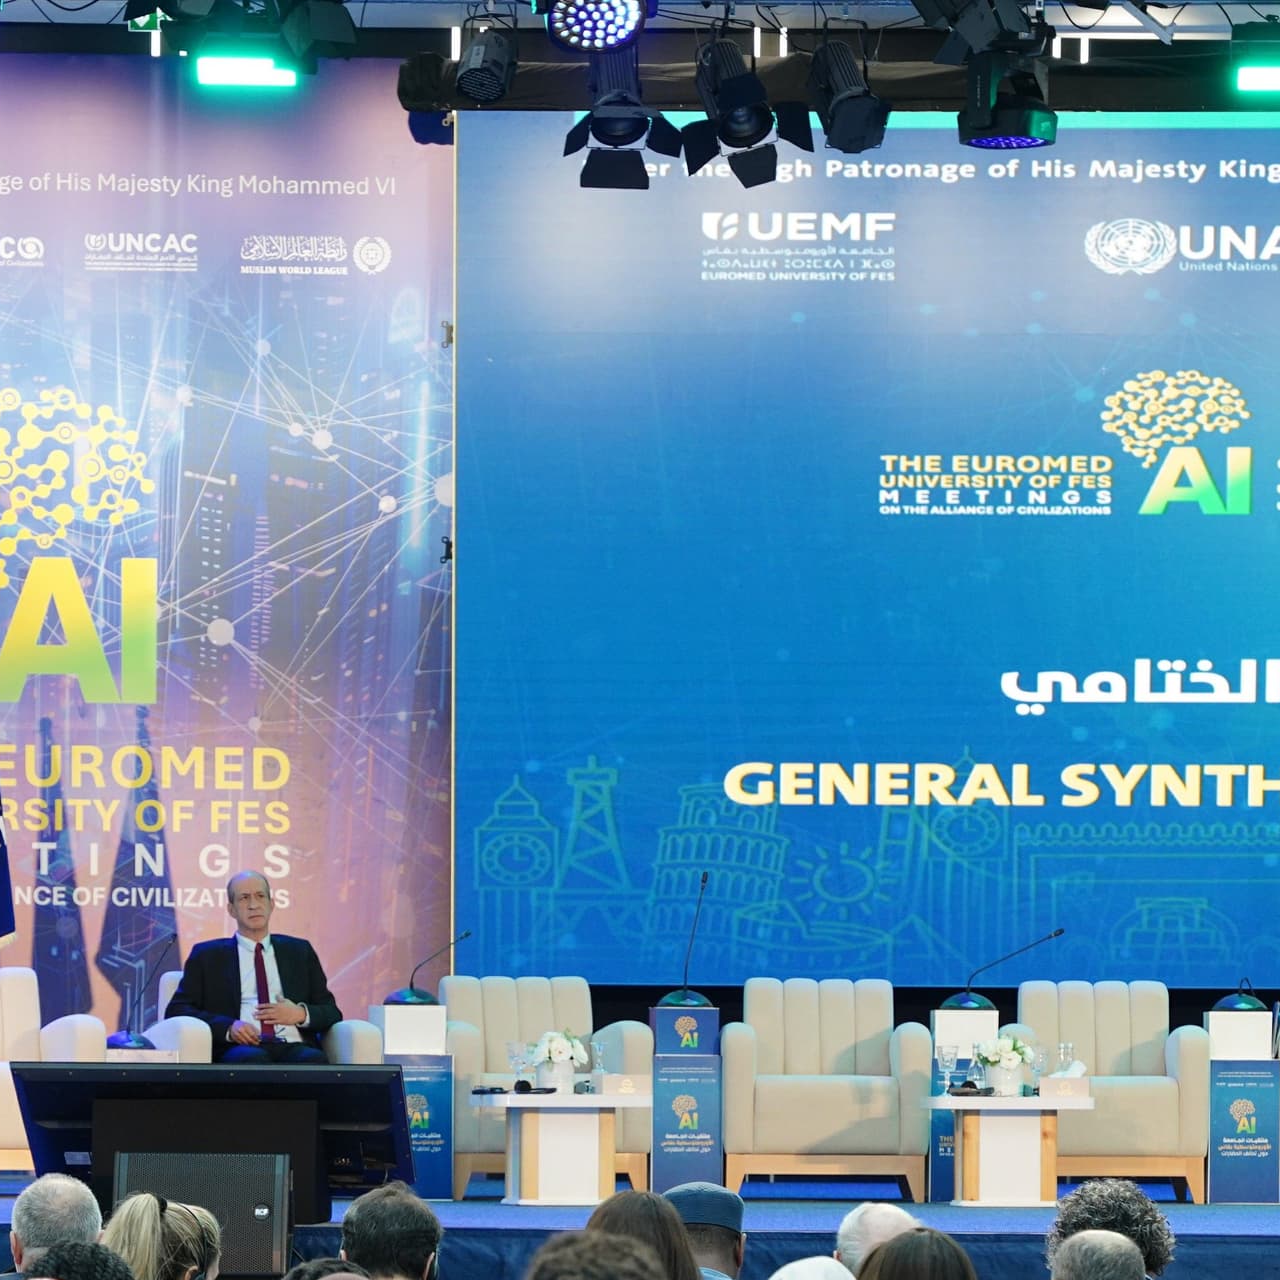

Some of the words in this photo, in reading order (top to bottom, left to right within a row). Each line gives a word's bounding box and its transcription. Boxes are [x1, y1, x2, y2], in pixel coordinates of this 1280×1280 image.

[826, 159, 977, 183] Patronage
[988, 159, 1019, 179] of
[1031, 159, 1076, 178] His
[1088, 159, 1207, 183] Majesty
[28, 172, 52, 192] of
[56, 173, 91, 192] His
[97, 173, 181, 197] Majesty
[187, 174, 233, 197] King
[239, 174, 369, 195] Mohammed
[375, 177, 396, 195] VI
[748, 212, 896, 241] UEMF
[108, 233, 198, 254] UNCAC
[240, 265, 277, 274] MUSLIM
[278, 266, 312, 274] WORLD
[313, 266, 349, 275] LEAGUE
[1179, 260, 1222, 272] United
[1227, 260, 1277, 272] Nations
[701, 272, 766, 281] EUROMED
[770, 272, 847, 281] UNIVERSITY
[849, 272, 866, 281] OF
[870, 272, 896, 281] FES
[880, 455, 942, 473] THE
[952, 455, 1113, 473] EUROMED
[879, 474, 1023, 489] UNIVERSITY
[1029, 474, 1062, 489] OF
[1068, 474, 1112, 489] FES
[1138, 447, 1252, 516] AI
[879, 489, 1112, 505] MEETINGS
[879, 505, 901, 515] ON
[903, 505, 929, 515] THE
[930, 505, 994, 515] ALLIANCE
[996, 505, 1016, 515] OF
[1017, 505, 1112, 515] CIVILIZATIONS
[722, 761, 1045, 807] GENERAL
[135, 800, 195, 832] OF
[210, 800, 291, 834] FES
[72, 888, 105, 906] OF
[111, 888, 290, 909] CIVILIZATS
[680, 1031, 699, 1048] AI
[410, 1111, 429, 1129] AI
[678, 1111, 699, 1130] AI
[1236, 1116, 1257, 1134] AI
